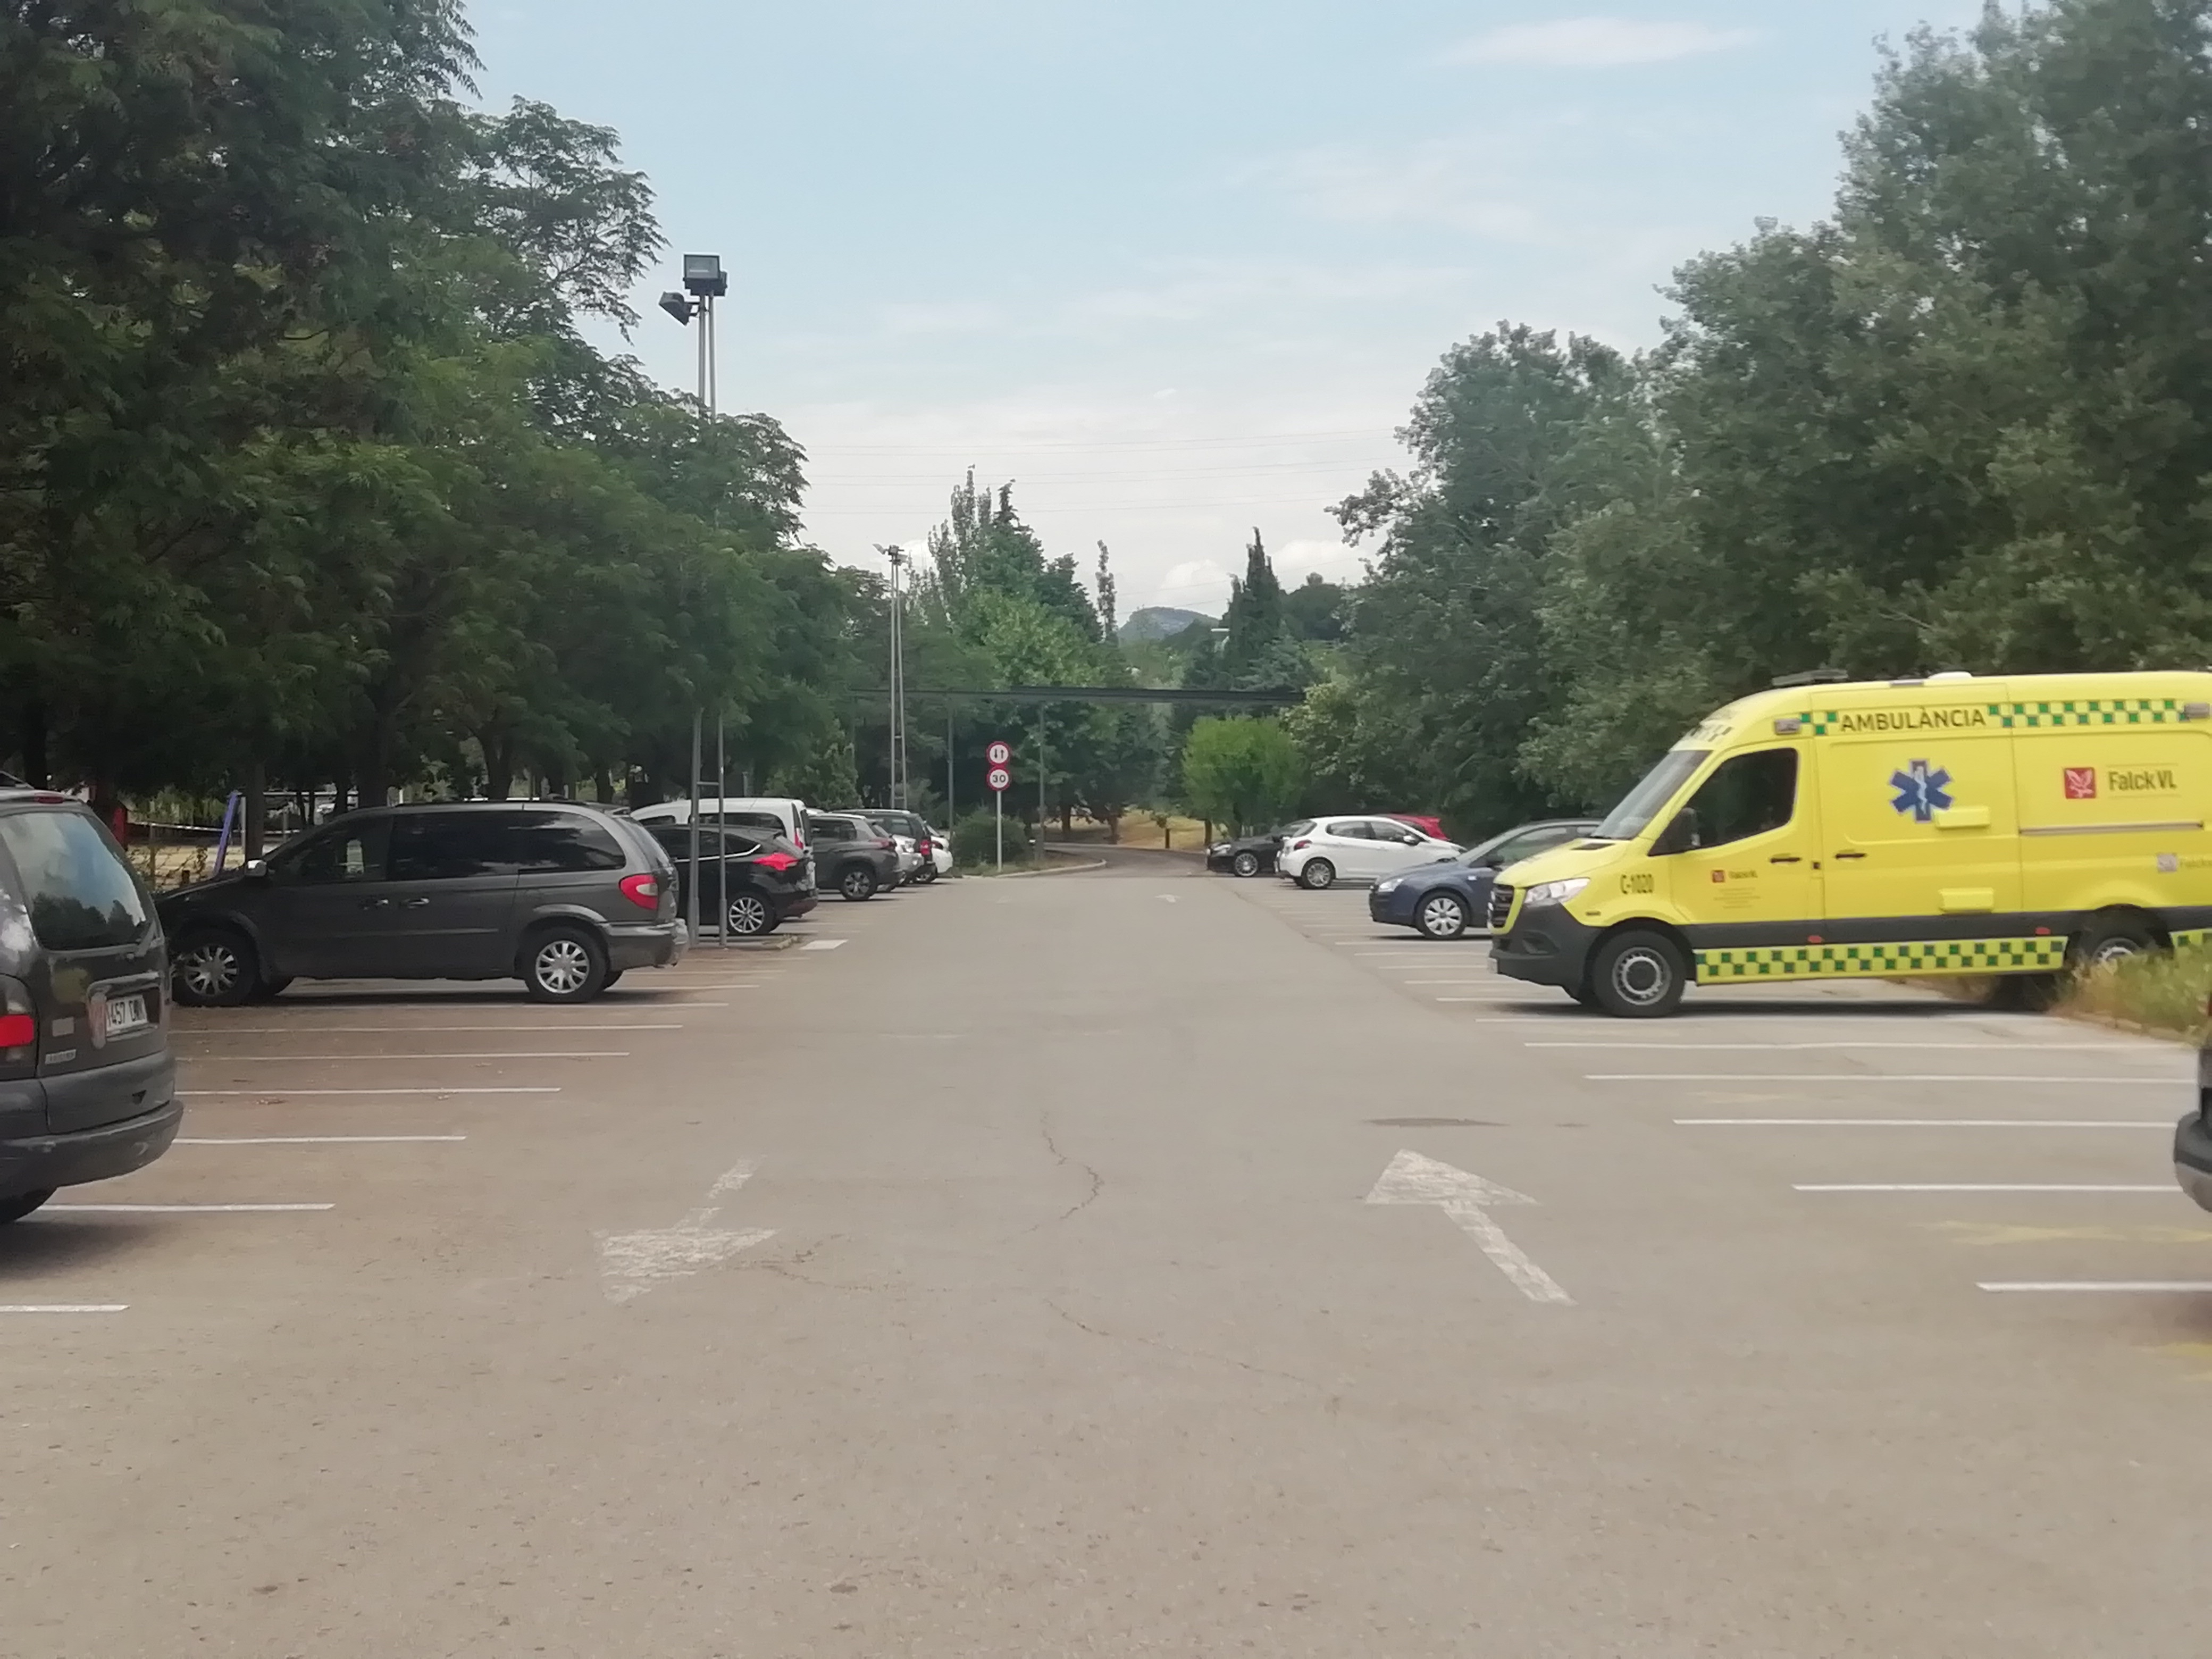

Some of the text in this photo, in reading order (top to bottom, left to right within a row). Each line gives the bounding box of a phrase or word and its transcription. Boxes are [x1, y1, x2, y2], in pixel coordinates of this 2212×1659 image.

[1840, 706, 1987, 732] AMBULÀNCIA
[992, 774, 1007, 783] 30
[2108, 770, 2177, 790] Falck VL
